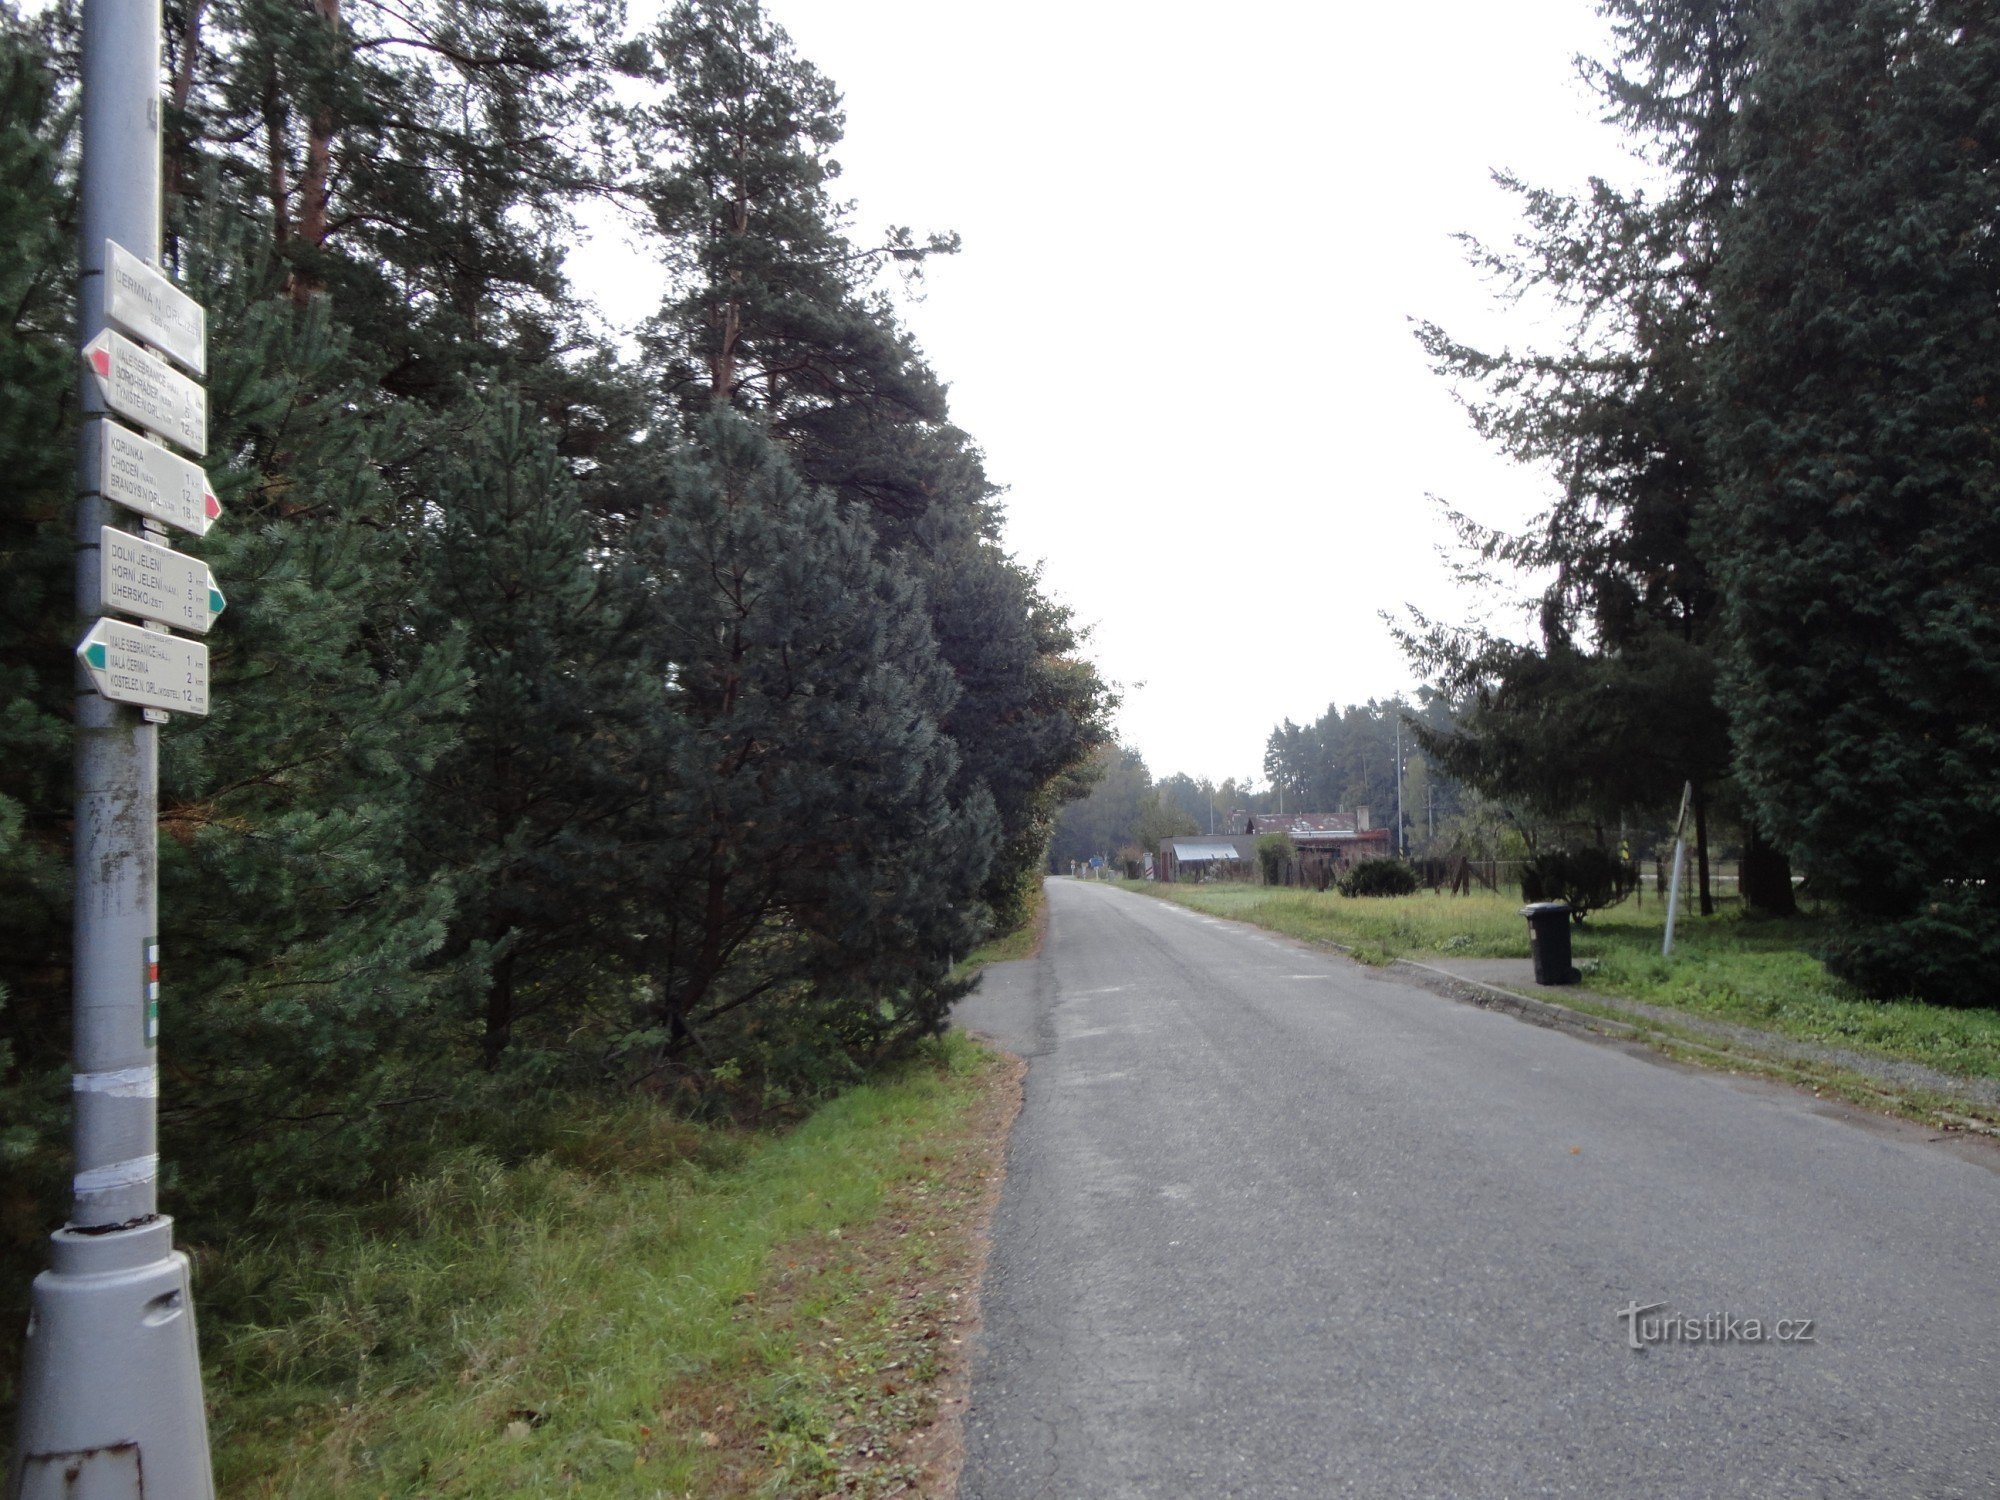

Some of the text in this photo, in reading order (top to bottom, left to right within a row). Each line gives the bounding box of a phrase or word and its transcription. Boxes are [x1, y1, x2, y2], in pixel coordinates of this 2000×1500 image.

[186, 473, 190, 485] 1
[182, 488, 191, 503] 12
[182, 506, 191, 520] 18
[187, 571, 193, 584] 3
[112, 582, 148, 605] UHERSKO
[183, 605, 193, 618] 15
[187, 588, 193, 601] 5
[186, 654, 191, 667] 1
[186, 672, 192, 684] 2
[182, 689, 192, 702] 12
